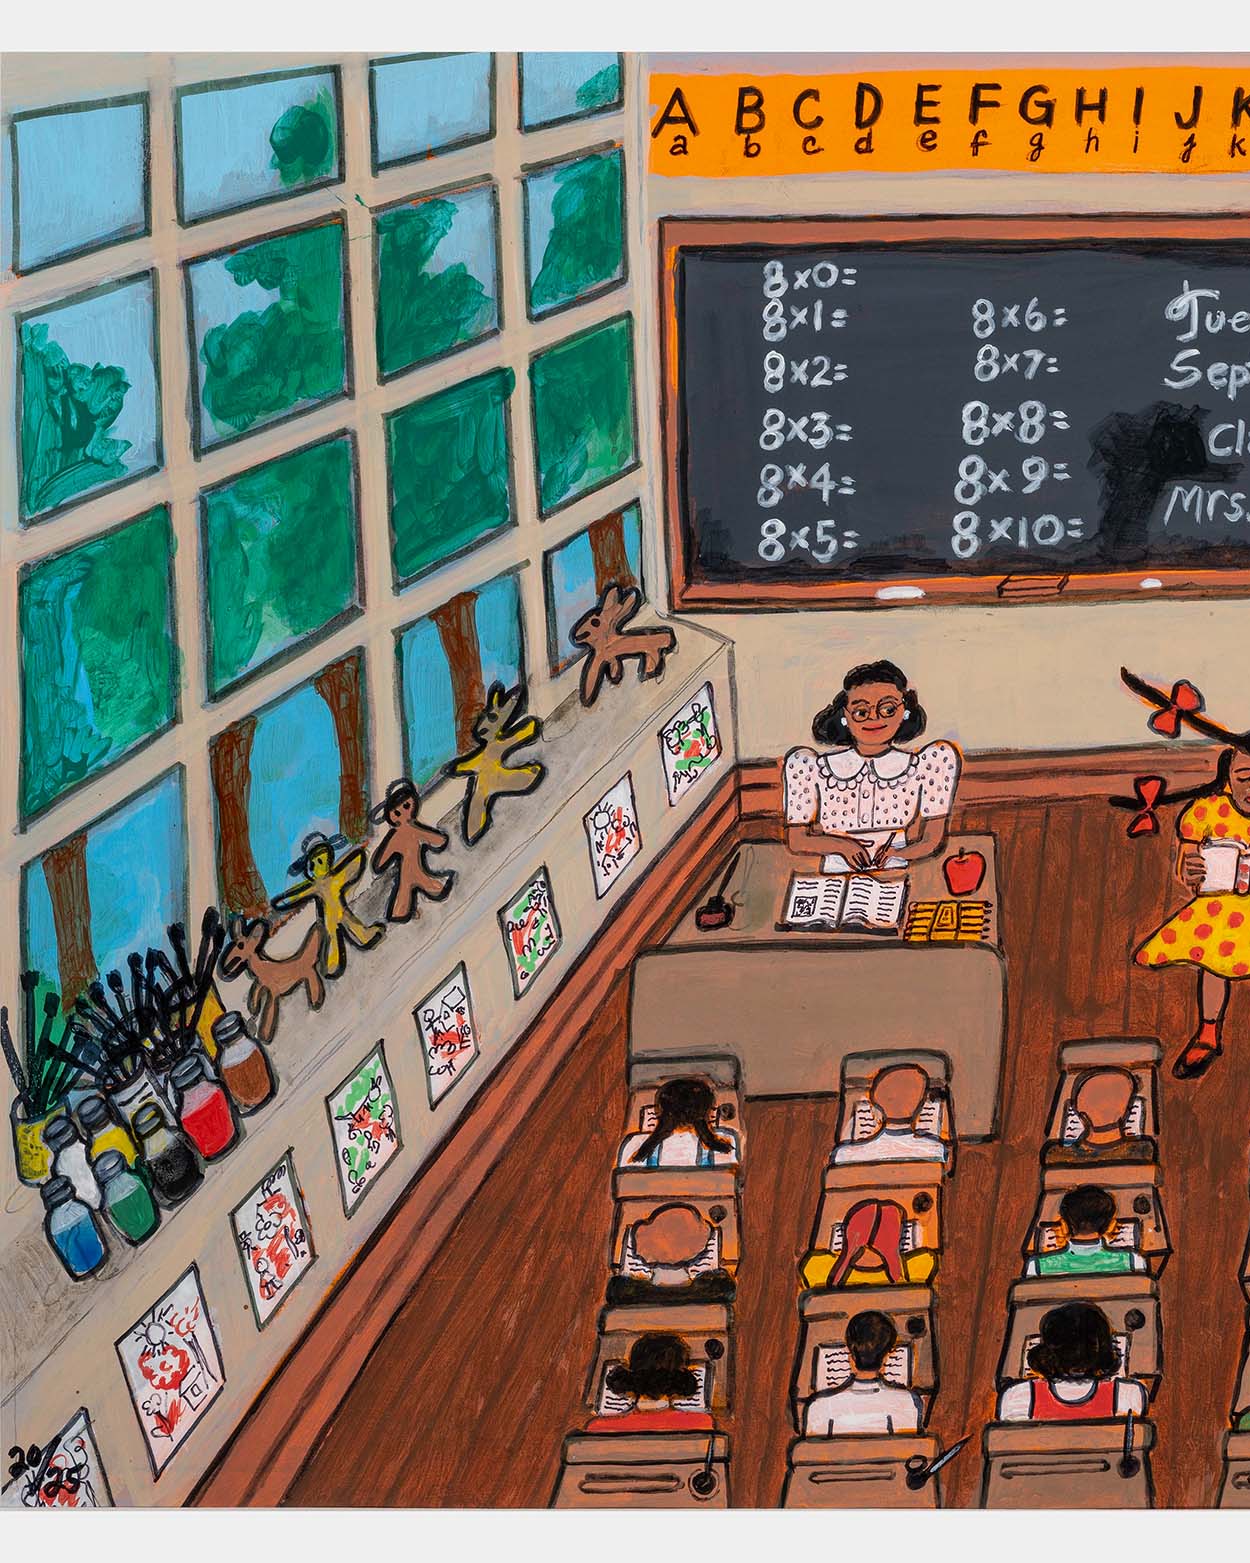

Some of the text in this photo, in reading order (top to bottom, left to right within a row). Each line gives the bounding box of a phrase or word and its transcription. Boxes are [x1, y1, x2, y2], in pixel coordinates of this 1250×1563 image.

[650, 88, 699, 140] A
[735, 86, 765, 138] B
[793, 89, 824, 130] C
[855, 82, 883, 133] D
[914, 83, 941, 127] E
[969, 83, 1002, 125] F
[1019, 85, 1056, 128] G
[1075, 87, 1108, 129] H
[1133, 87, 1144, 128] I
[1174, 86, 1203, 130] J
[670, 135, 691, 156] a
[741, 129, 761, 158] b
[802, 136, 824, 155] c
[854, 129, 874, 154] d
[919, 130, 937, 152] e
[971, 130, 989, 156] f
[1027, 132, 1044, 162] g
[1085, 128, 1099, 153] h
[1133, 127, 1139, 153] i
[1179, 133, 1196, 162] j
[1229, 134, 1246, 158] k
[1164, 485, 1250, 525] Mrs.
